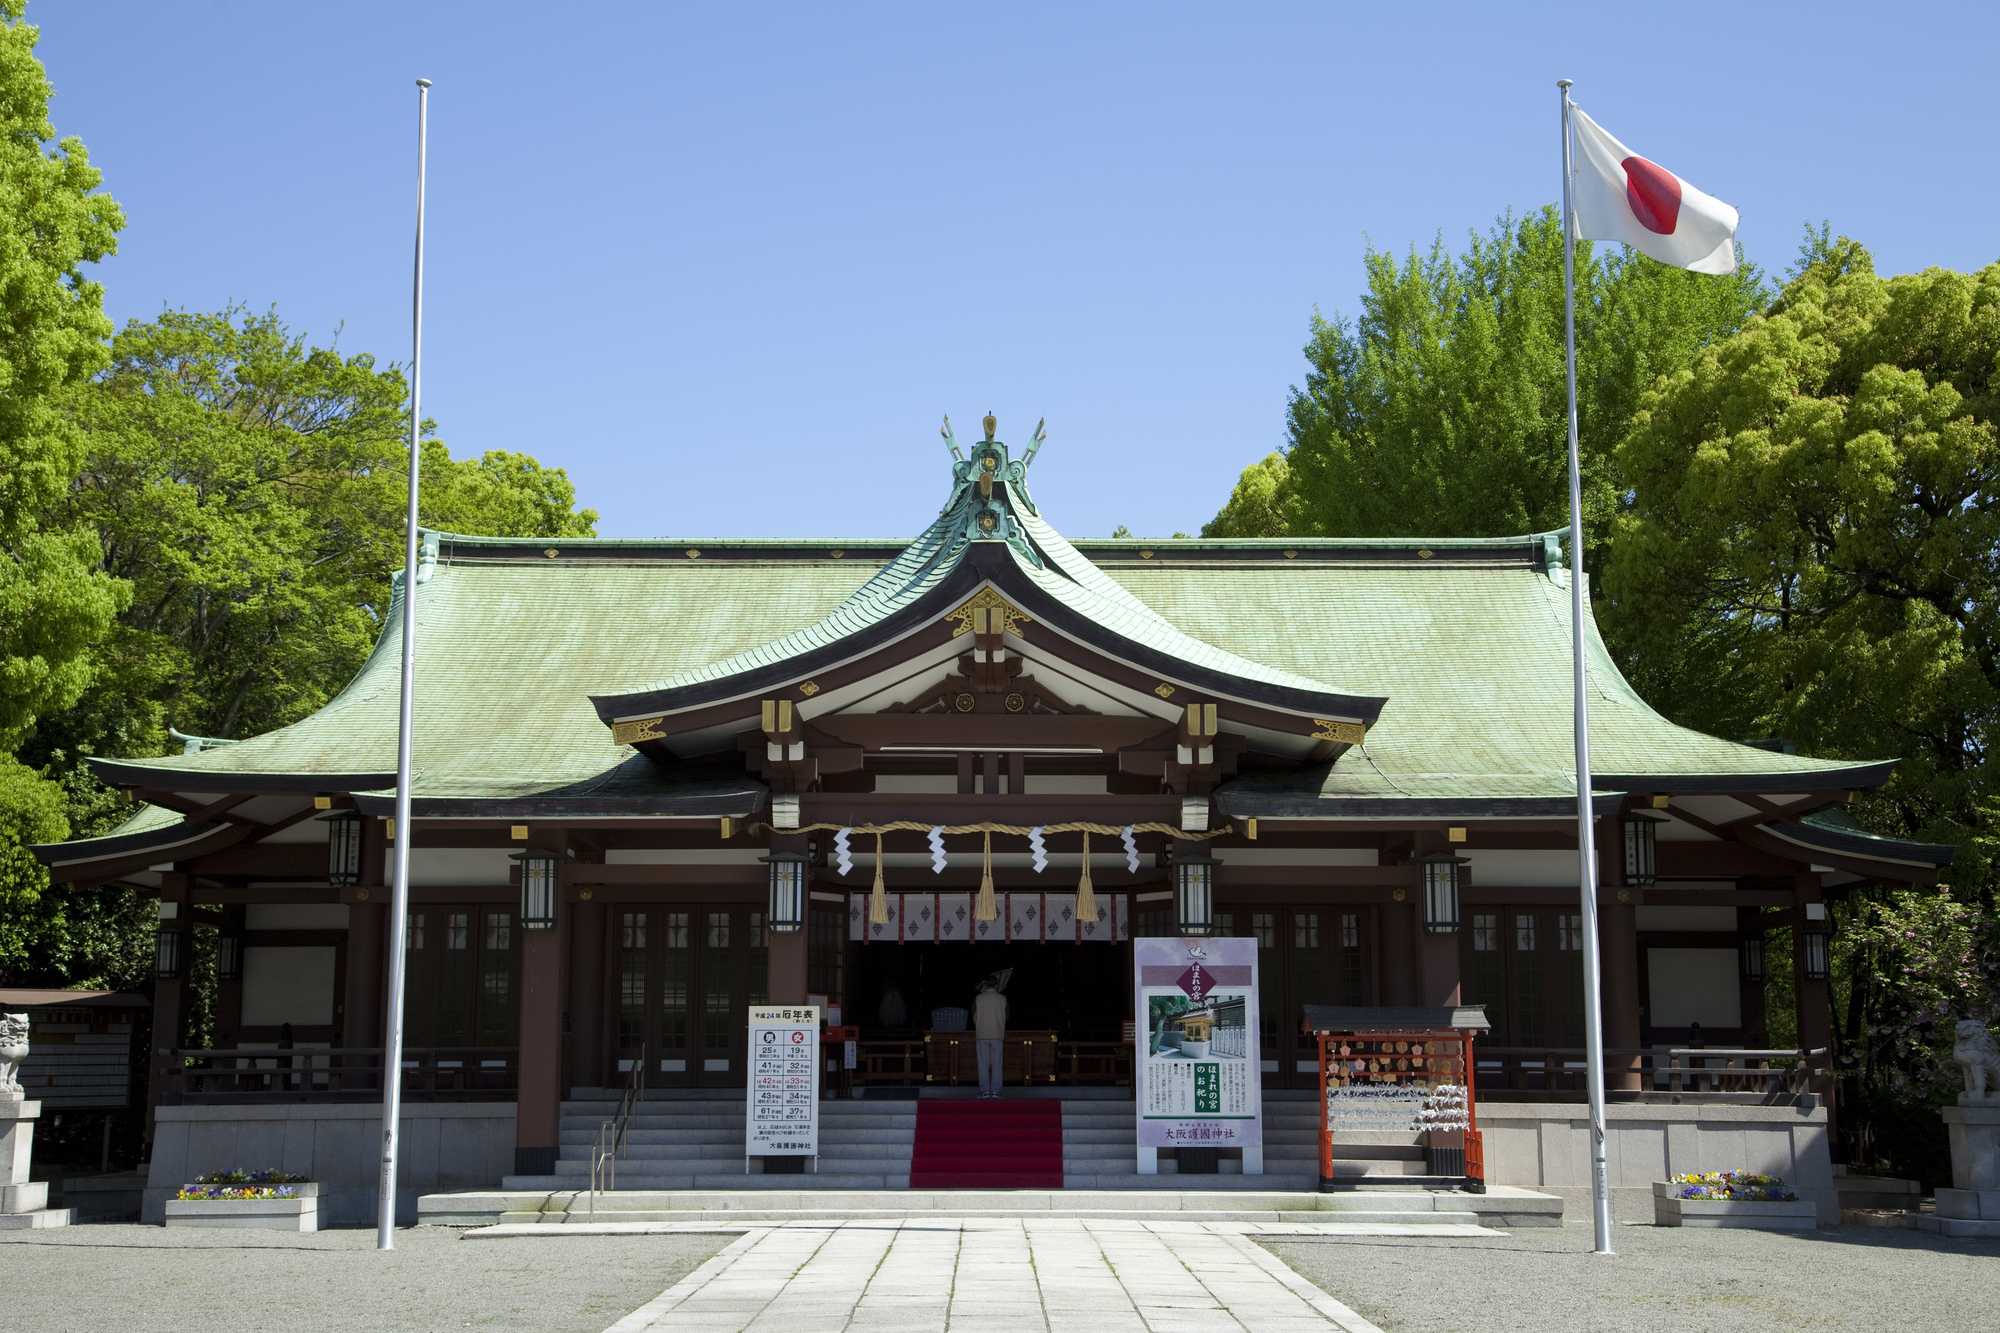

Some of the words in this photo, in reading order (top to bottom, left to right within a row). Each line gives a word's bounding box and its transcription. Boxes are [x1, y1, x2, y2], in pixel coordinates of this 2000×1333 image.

[1191, 965, 1202, 1000] ほまれの宮
[765, 1033, 775, 1044] 男
[793, 1033, 803, 1043] 女
[1196, 1065, 1207, 1109] のお祀り
[1208, 1065, 1218, 1109] ほまれの宮
[1165, 1127, 1235, 1139] 大阪護國神社
